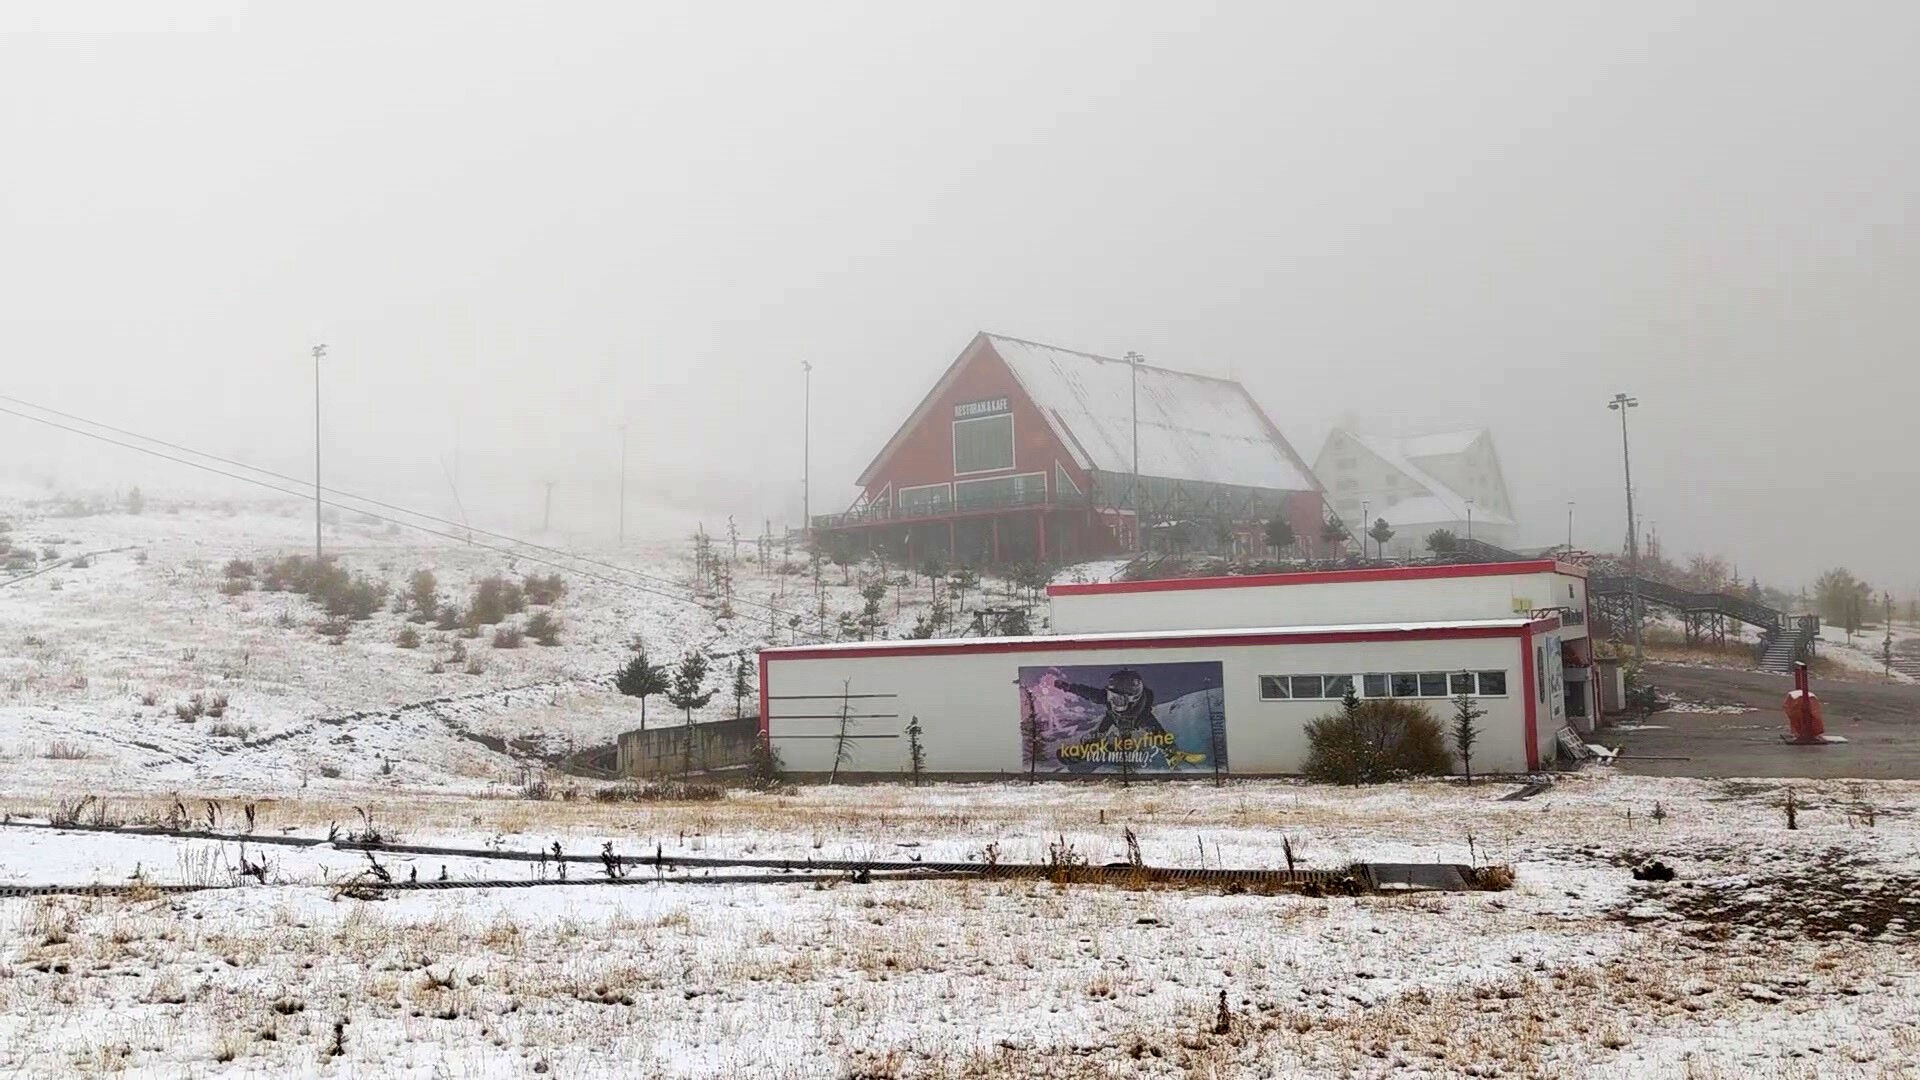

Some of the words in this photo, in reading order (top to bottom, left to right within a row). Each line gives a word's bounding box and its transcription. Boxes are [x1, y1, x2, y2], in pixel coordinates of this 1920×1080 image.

[991, 398, 1008, 411] KAFE
[1060, 738, 1109, 759] kayak
[1114, 732, 1175, 752] keyfine
